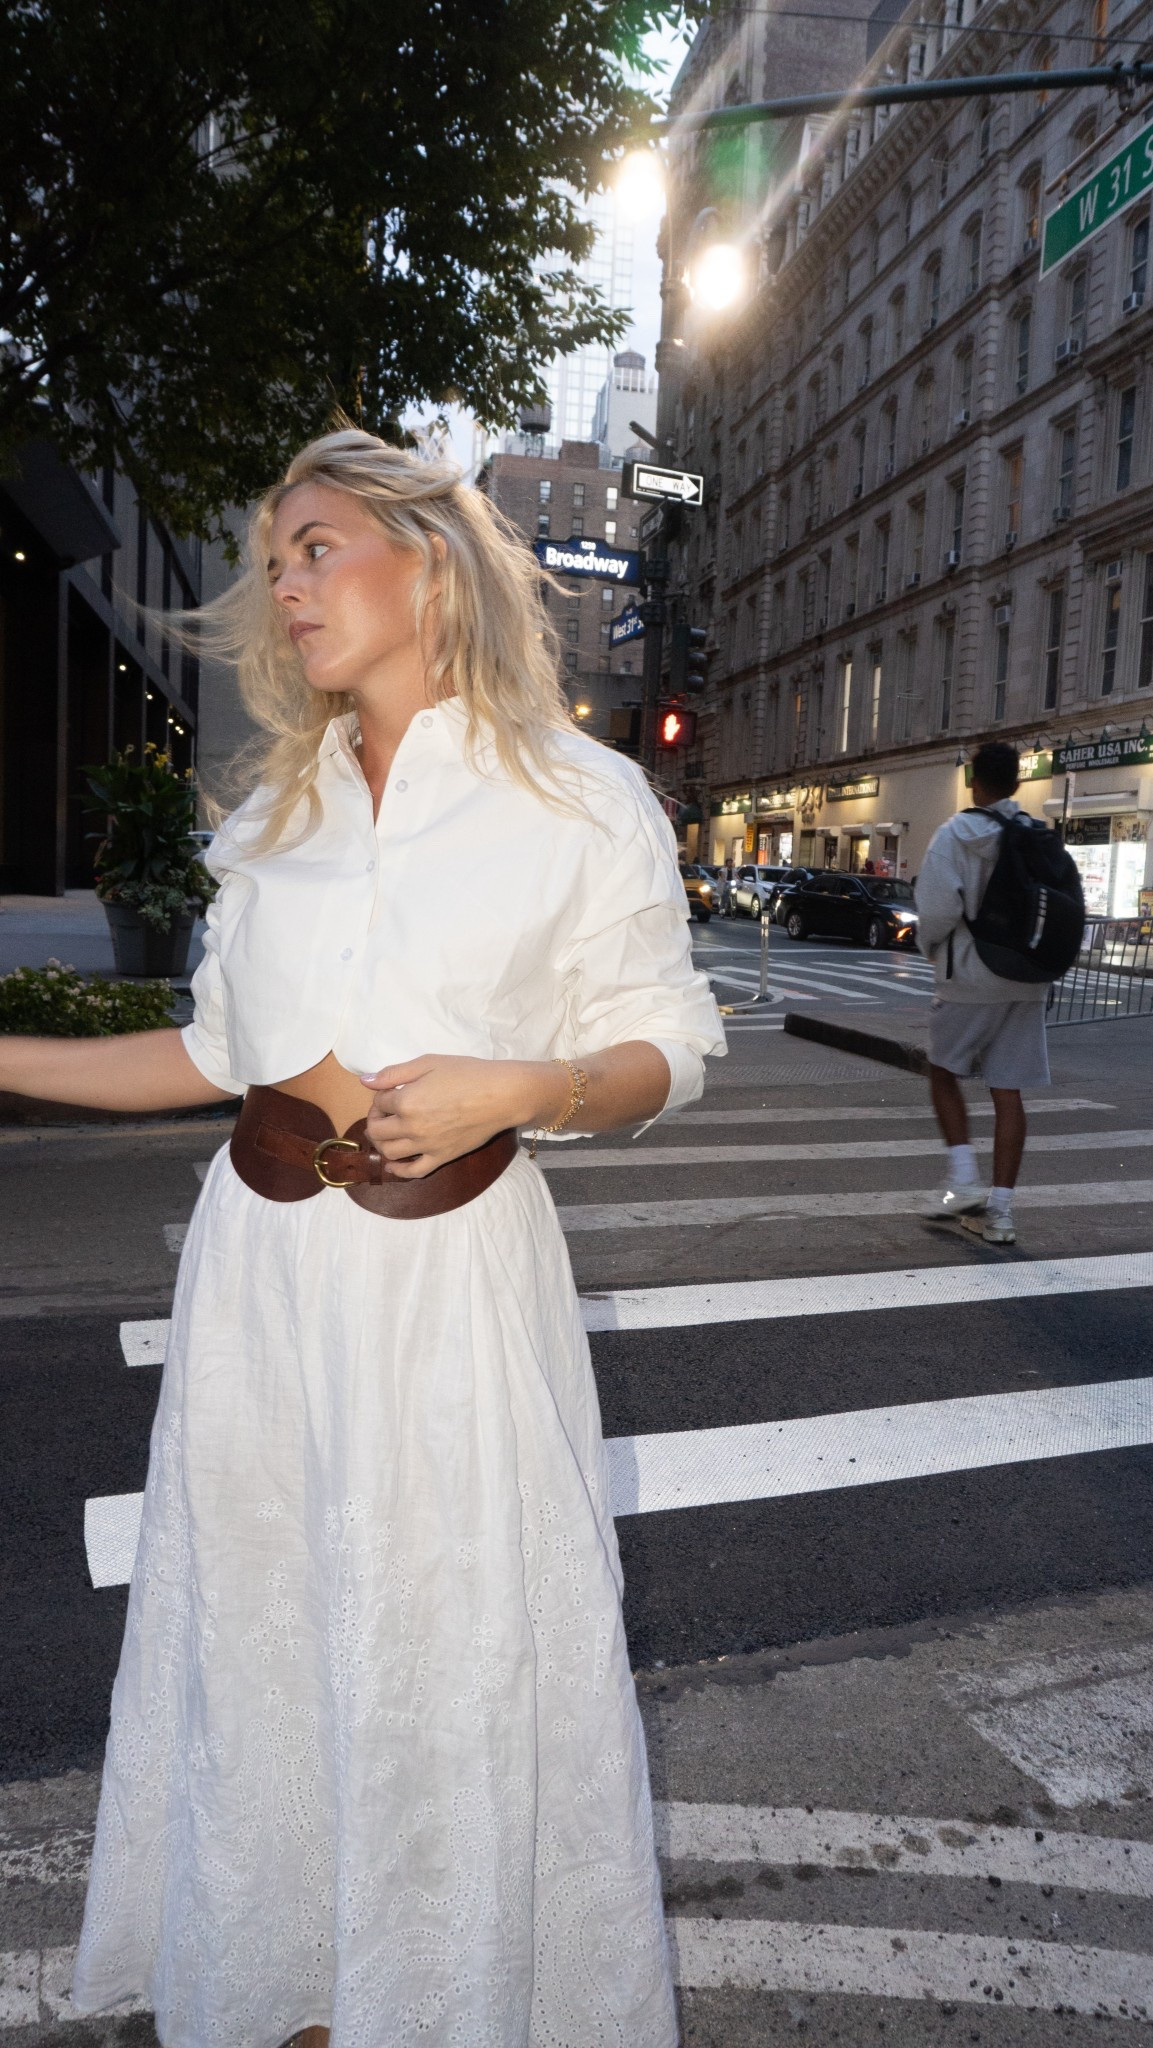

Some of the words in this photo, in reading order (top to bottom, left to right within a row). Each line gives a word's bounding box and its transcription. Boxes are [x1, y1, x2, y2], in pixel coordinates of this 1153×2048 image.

[1079, 183, 1099, 232] W
[1107, 153, 1132, 209] 31
[646, 475, 663, 488] ONE
[672, 481, 692, 493] WAY
[545, 546, 629, 579] Broadway
[612, 622, 627, 640] West
[1059, 746, 1095, 764] SAHER
[1098, 741, 1122, 758] USA
[1123, 738, 1148, 754] INC.
